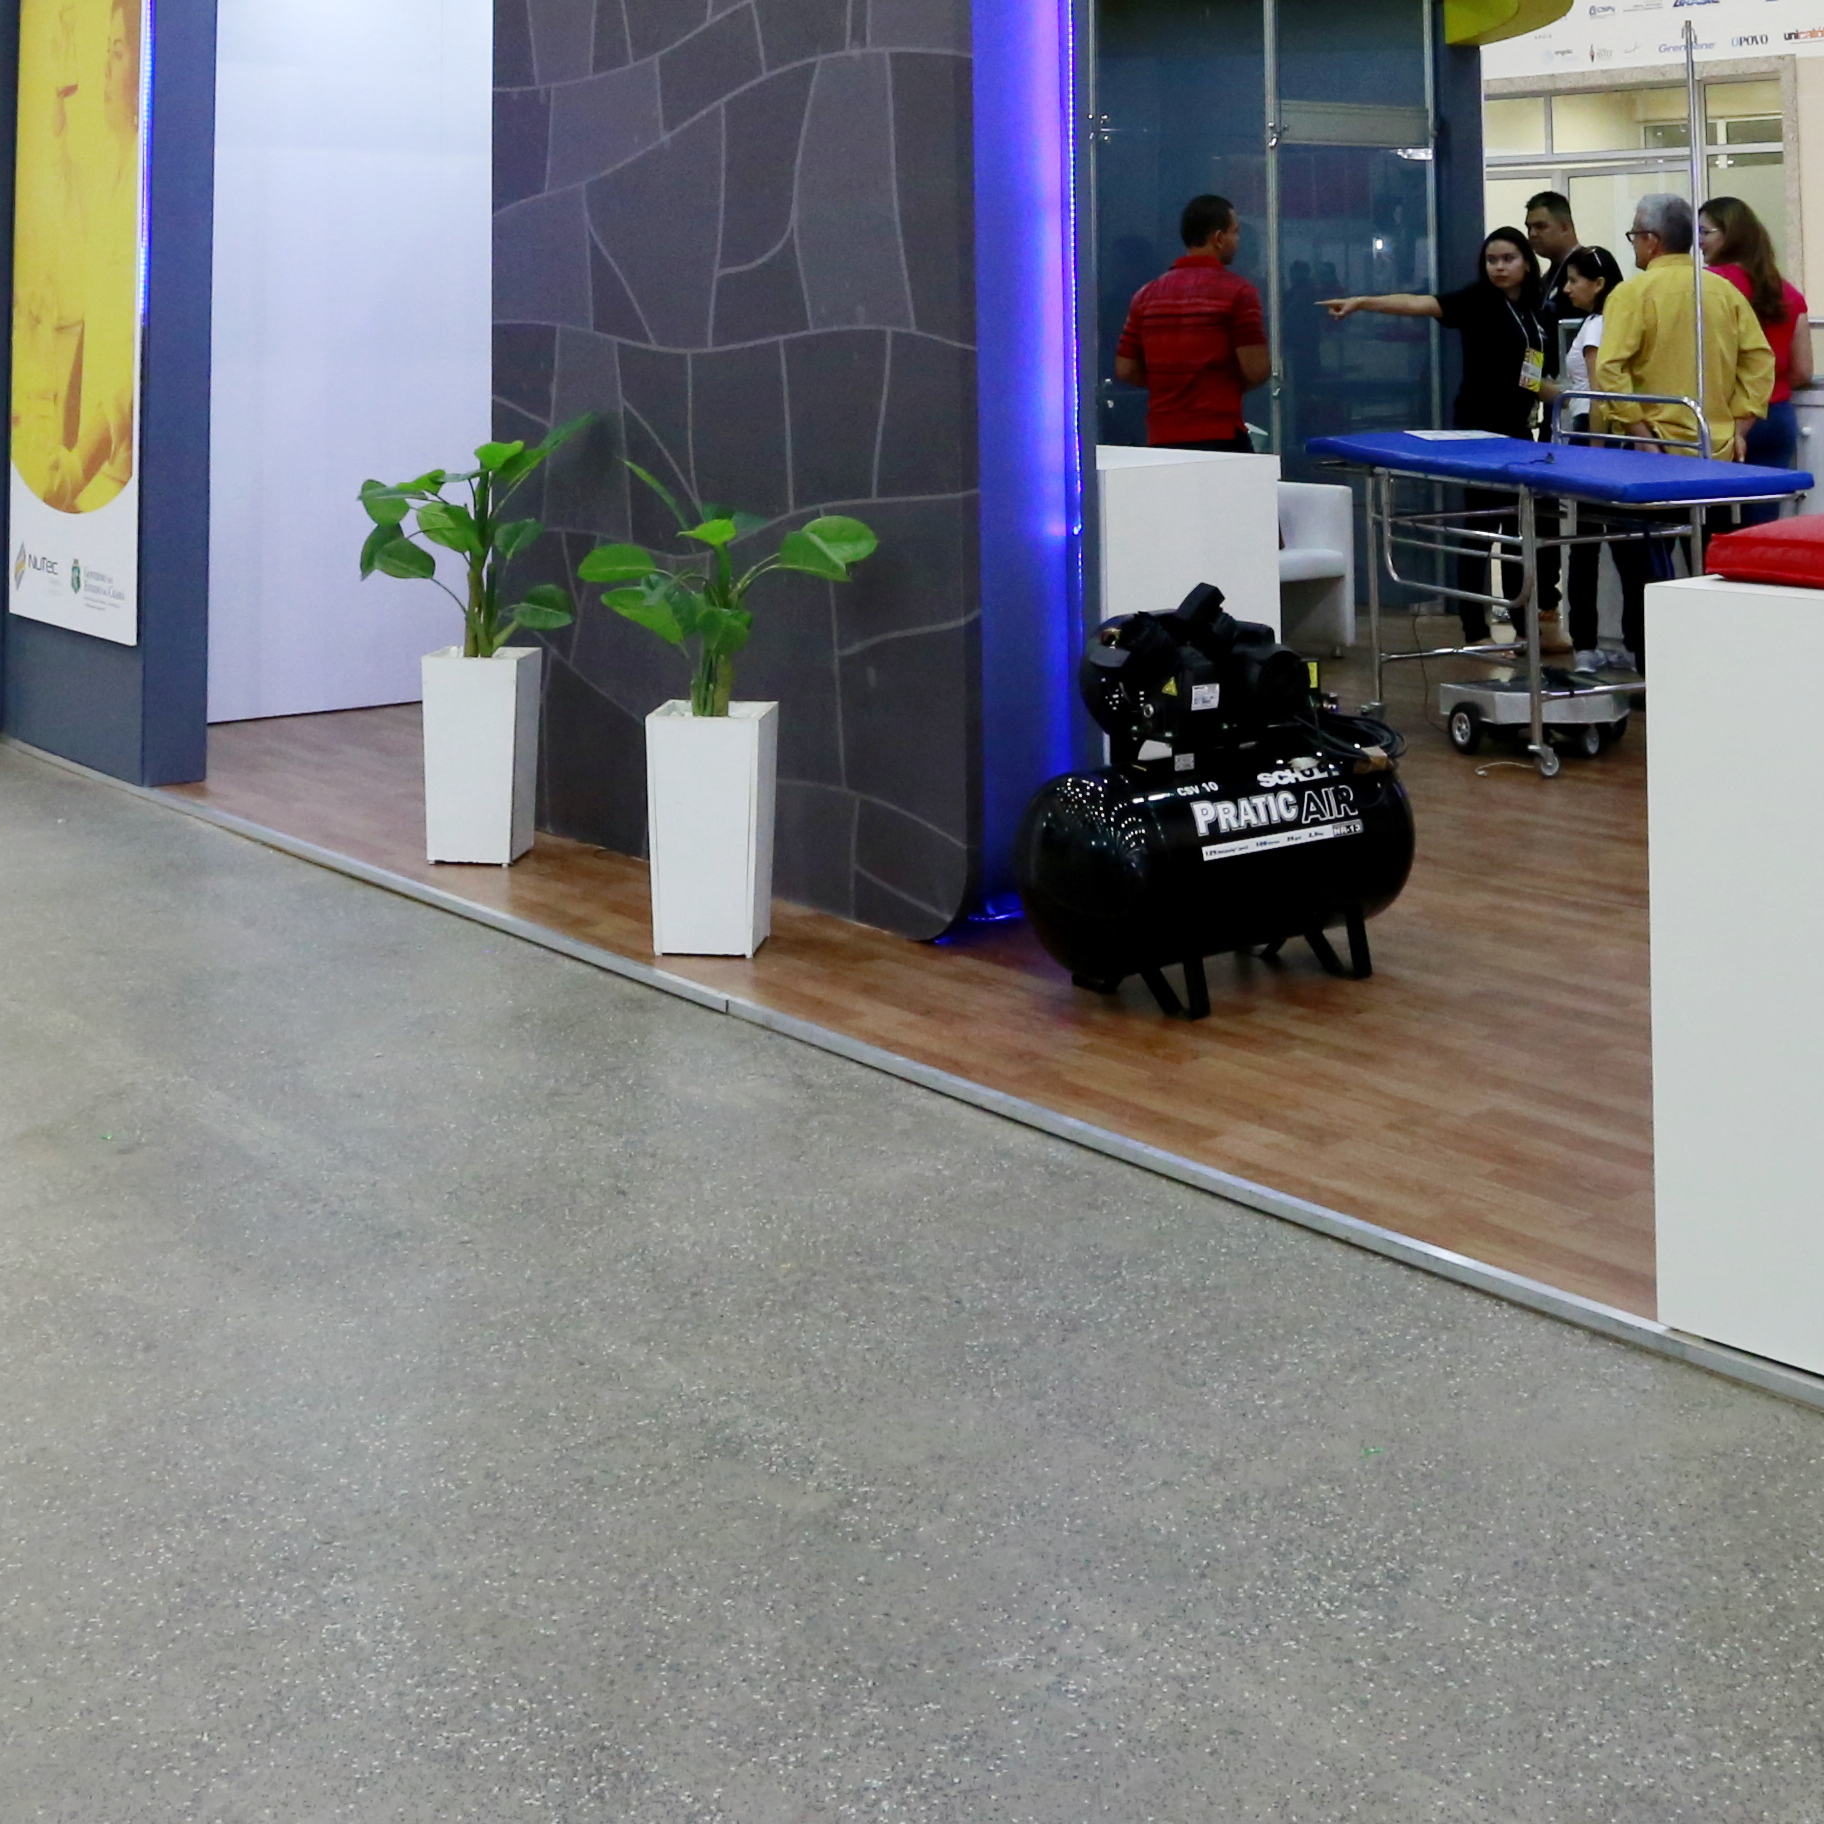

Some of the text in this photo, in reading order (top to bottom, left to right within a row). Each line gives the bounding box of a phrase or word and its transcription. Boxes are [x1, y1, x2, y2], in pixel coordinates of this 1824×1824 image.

[1256, 764, 1340, 788] SCHUL
[1176, 781, 1219, 797] CSV 10
[1190, 784, 1359, 837] PRATIC AIR
